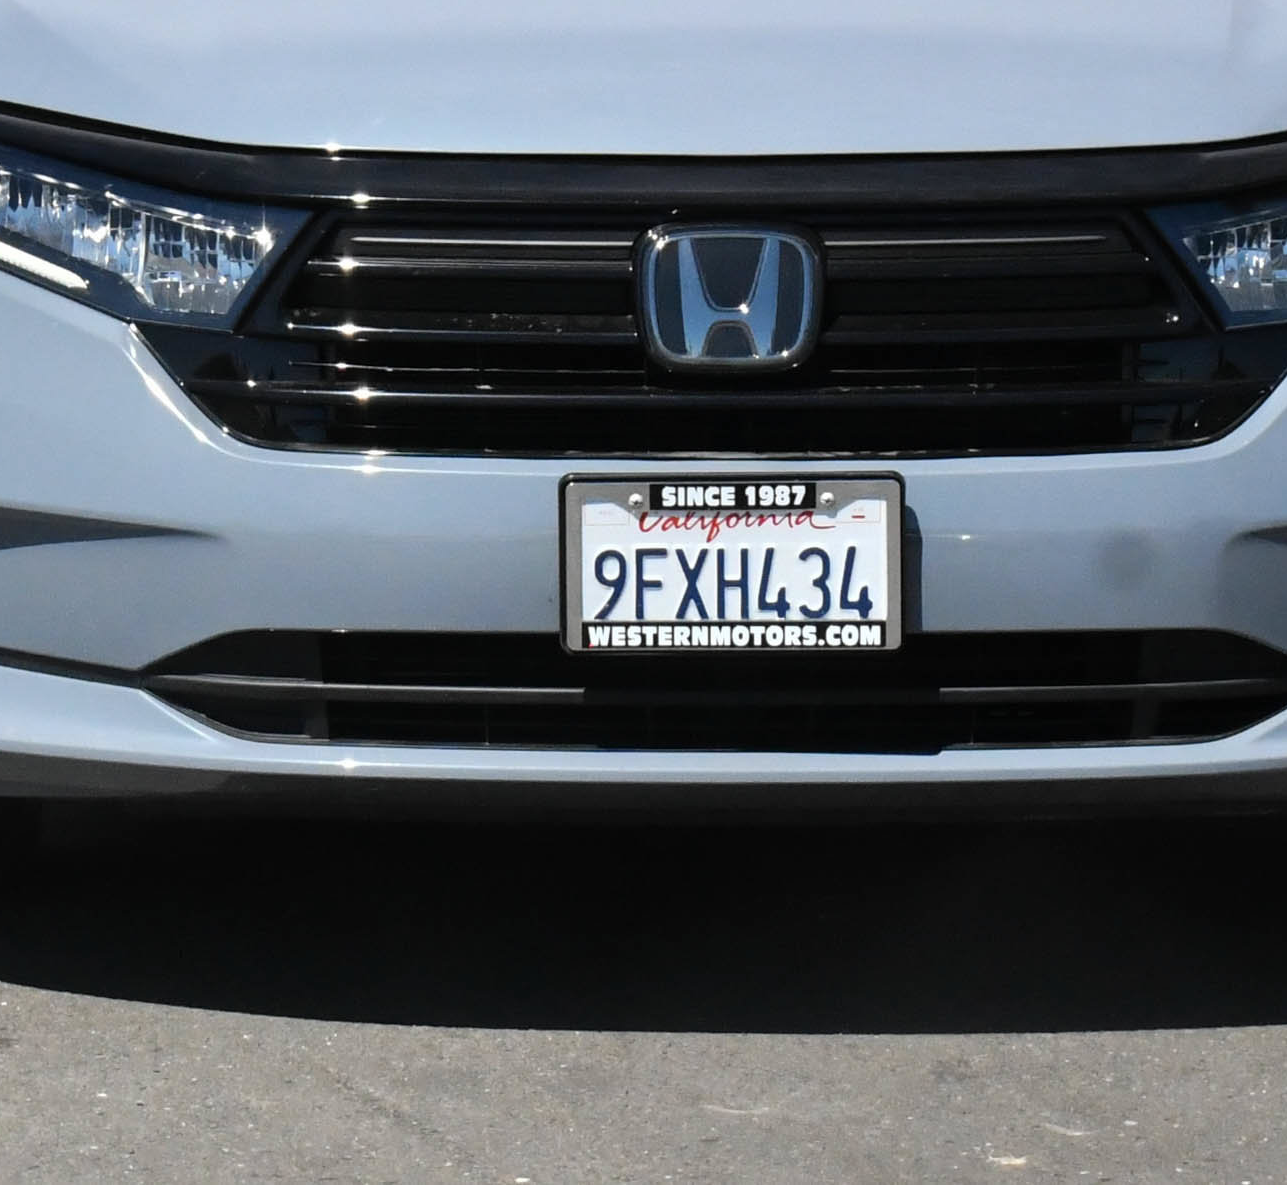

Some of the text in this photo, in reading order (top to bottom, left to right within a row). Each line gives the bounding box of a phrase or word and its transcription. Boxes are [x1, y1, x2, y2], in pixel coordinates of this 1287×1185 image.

[662, 485, 806, 507] SINCE 1987
[593, 546, 874, 620] 9FXH434
[587, 625, 882, 647] WESTERNMOTORS.COM
